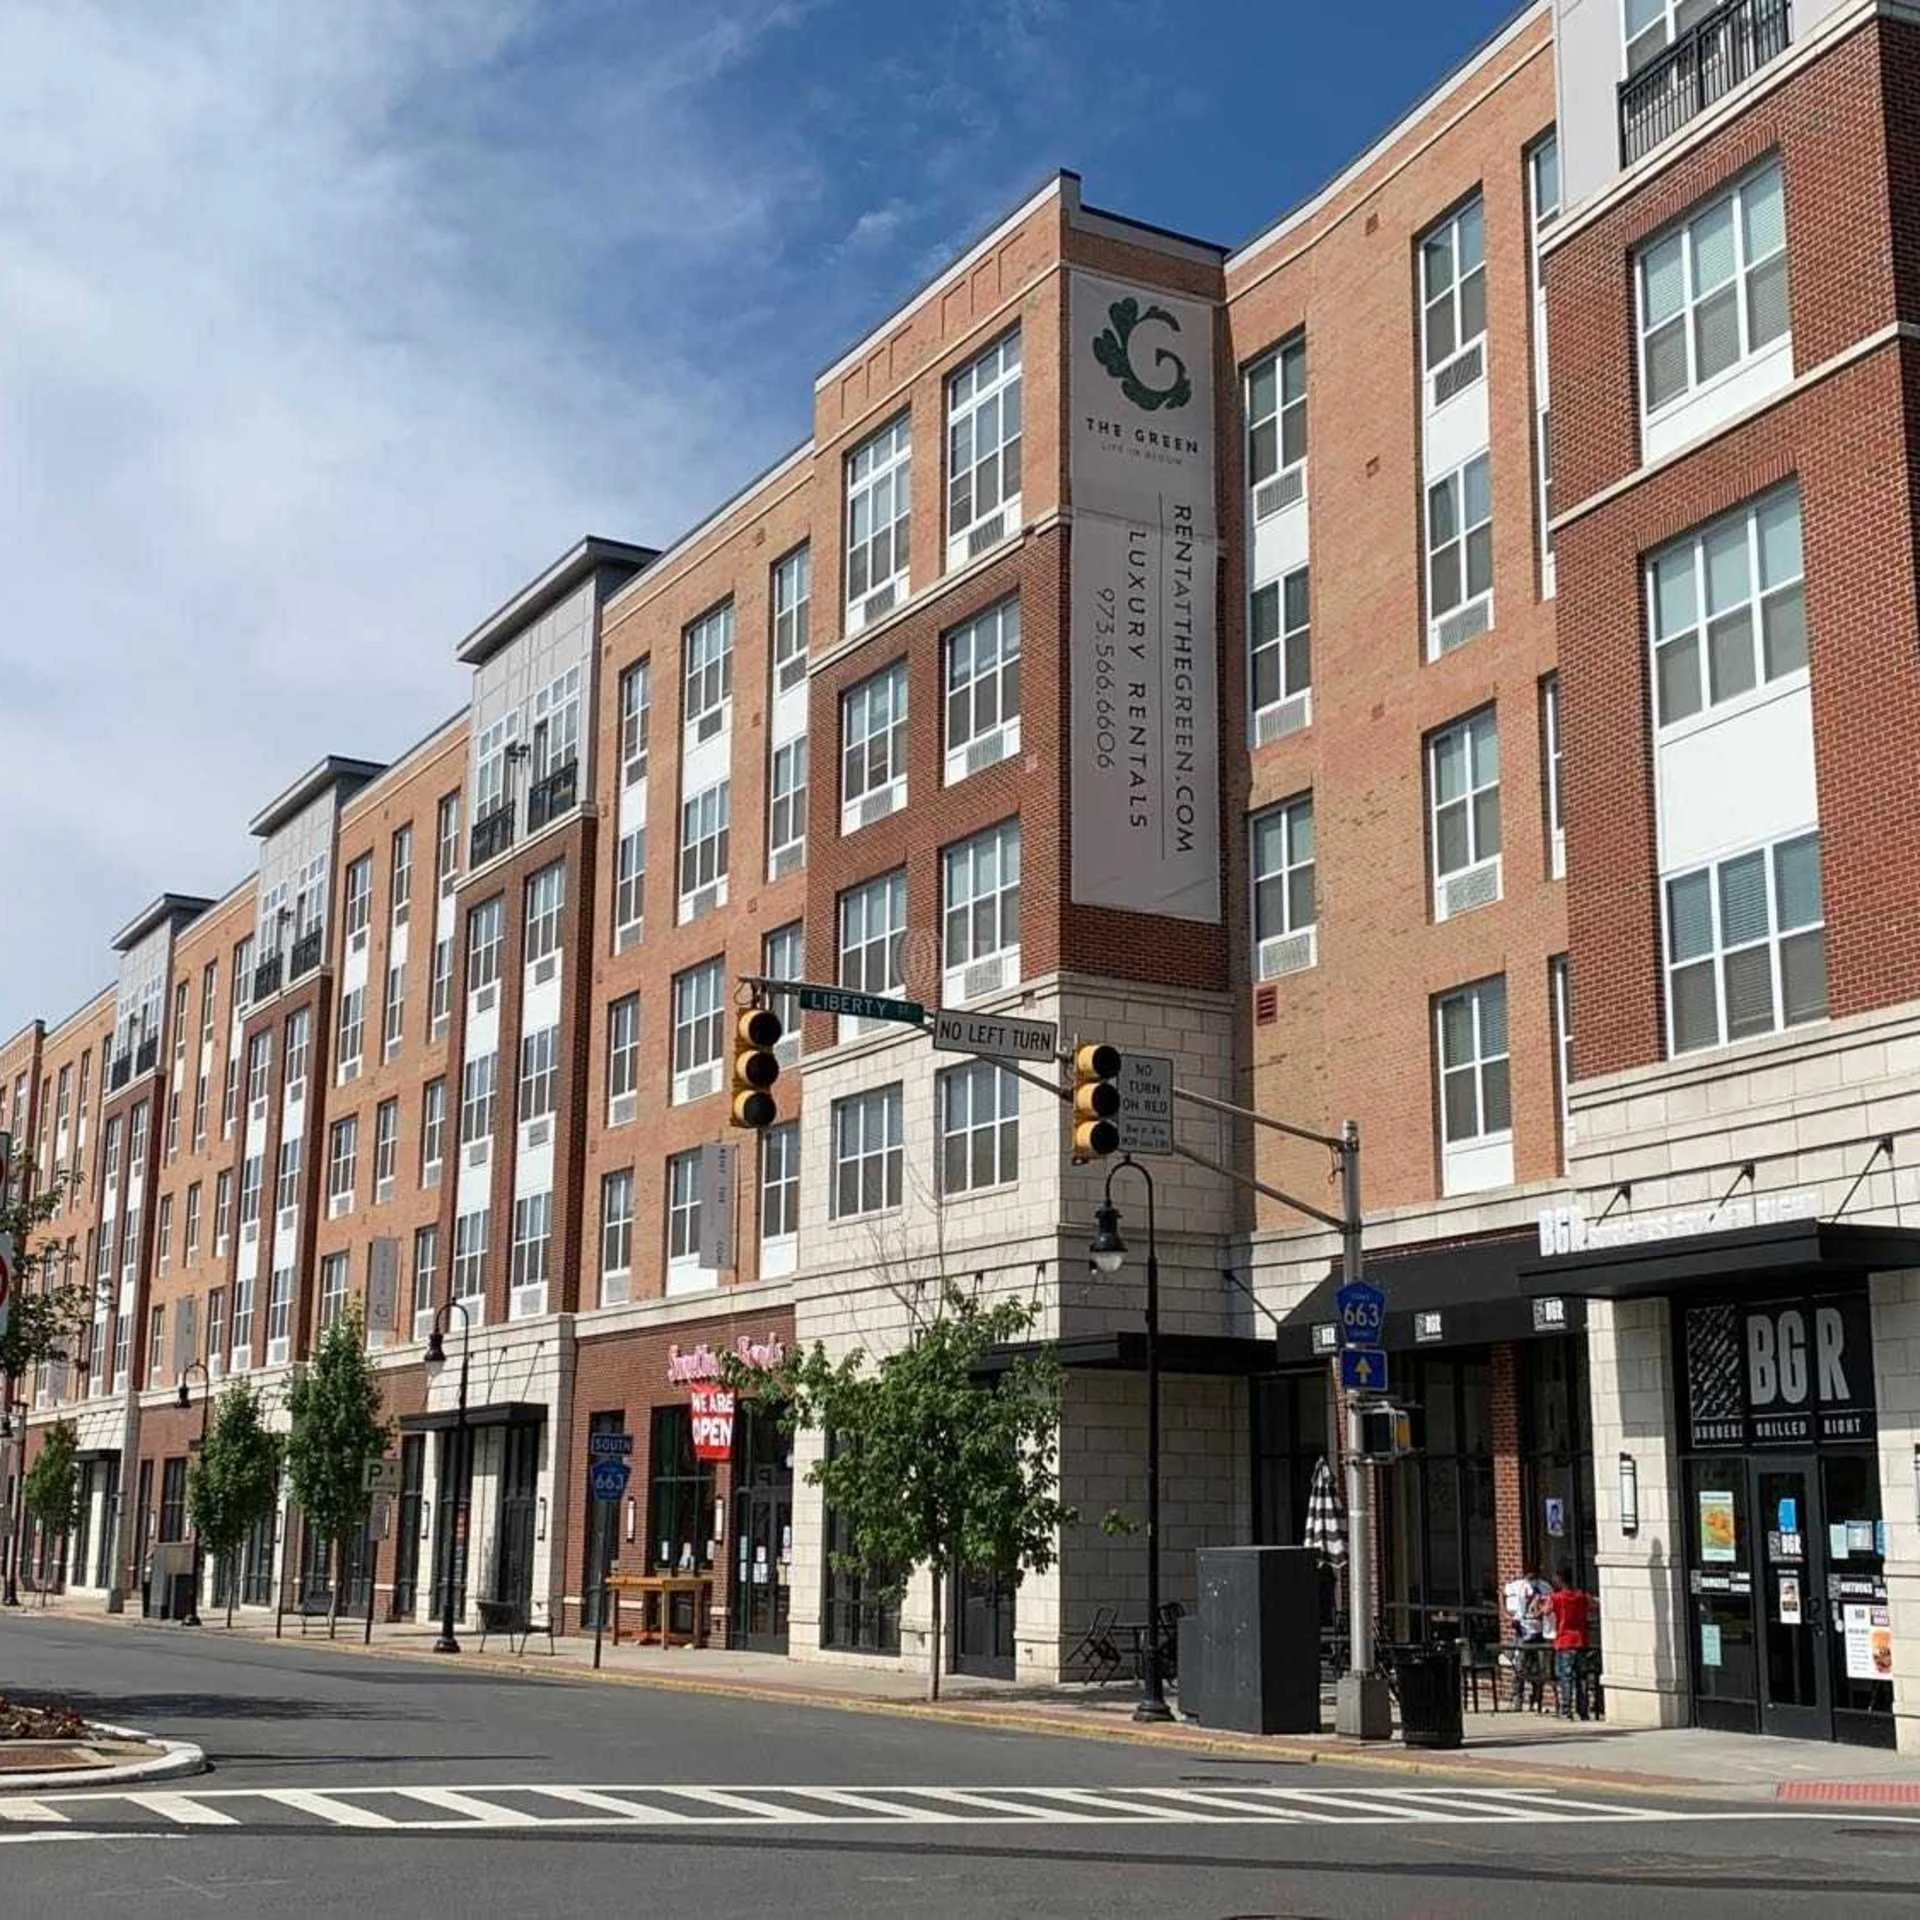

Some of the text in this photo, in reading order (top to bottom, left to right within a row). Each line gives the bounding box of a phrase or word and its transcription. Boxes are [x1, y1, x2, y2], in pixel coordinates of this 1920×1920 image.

[1086, 418, 1198, 454] THE GREEN
[1095, 587, 1117, 769] 973.566.6606
[1127, 530, 1148, 828] LUXURY RENTALS
[1173, 504, 1195, 853] RENTATTHEGREEN.COM
[810, 993, 888, 1017] LIBERTY
[939, 1022, 1051, 1051] NO LEFT TURN
[1135, 1063, 1152, 1077] NO
[1129, 1080, 1160, 1094] TURN
[1122, 1098, 1167, 1114] ON RED
[1344, 1302, 1379, 1327] 663
[1747, 1308, 1851, 1405] BGR
[691, 1392, 735, 1412] WE ARE
[692, 1417, 734, 1447] OPEN
[1756, 1421, 1807, 1437] GRILLED
[1824, 1418, 1861, 1434] RIGHT
[595, 1438, 631, 1450] SOUTH
[595, 1474, 624, 1490] 663
